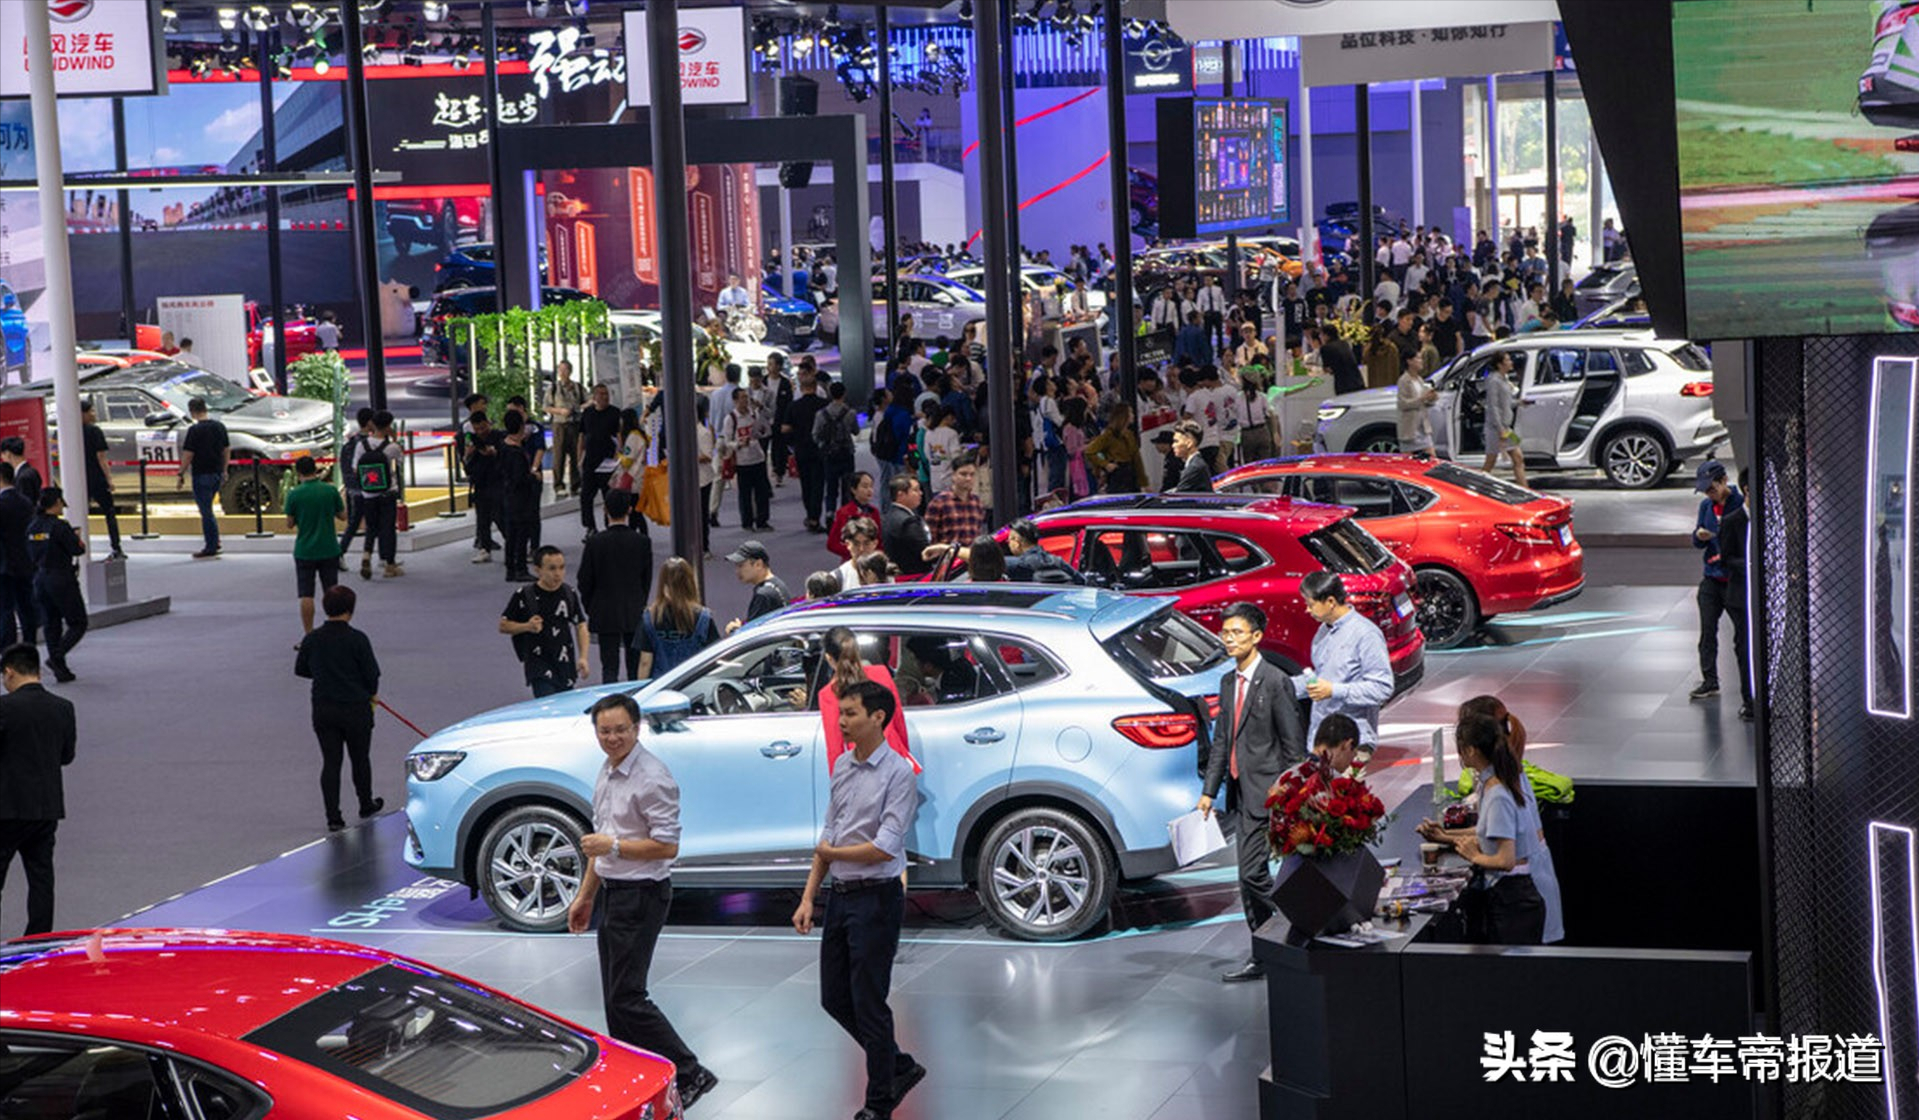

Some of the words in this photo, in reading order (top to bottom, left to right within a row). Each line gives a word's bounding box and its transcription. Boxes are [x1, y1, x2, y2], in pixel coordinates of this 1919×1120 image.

[23, 32, 114, 54] 风汽车
[24, 55, 115, 72] LDWIND
[142, 446, 174, 462] 581
